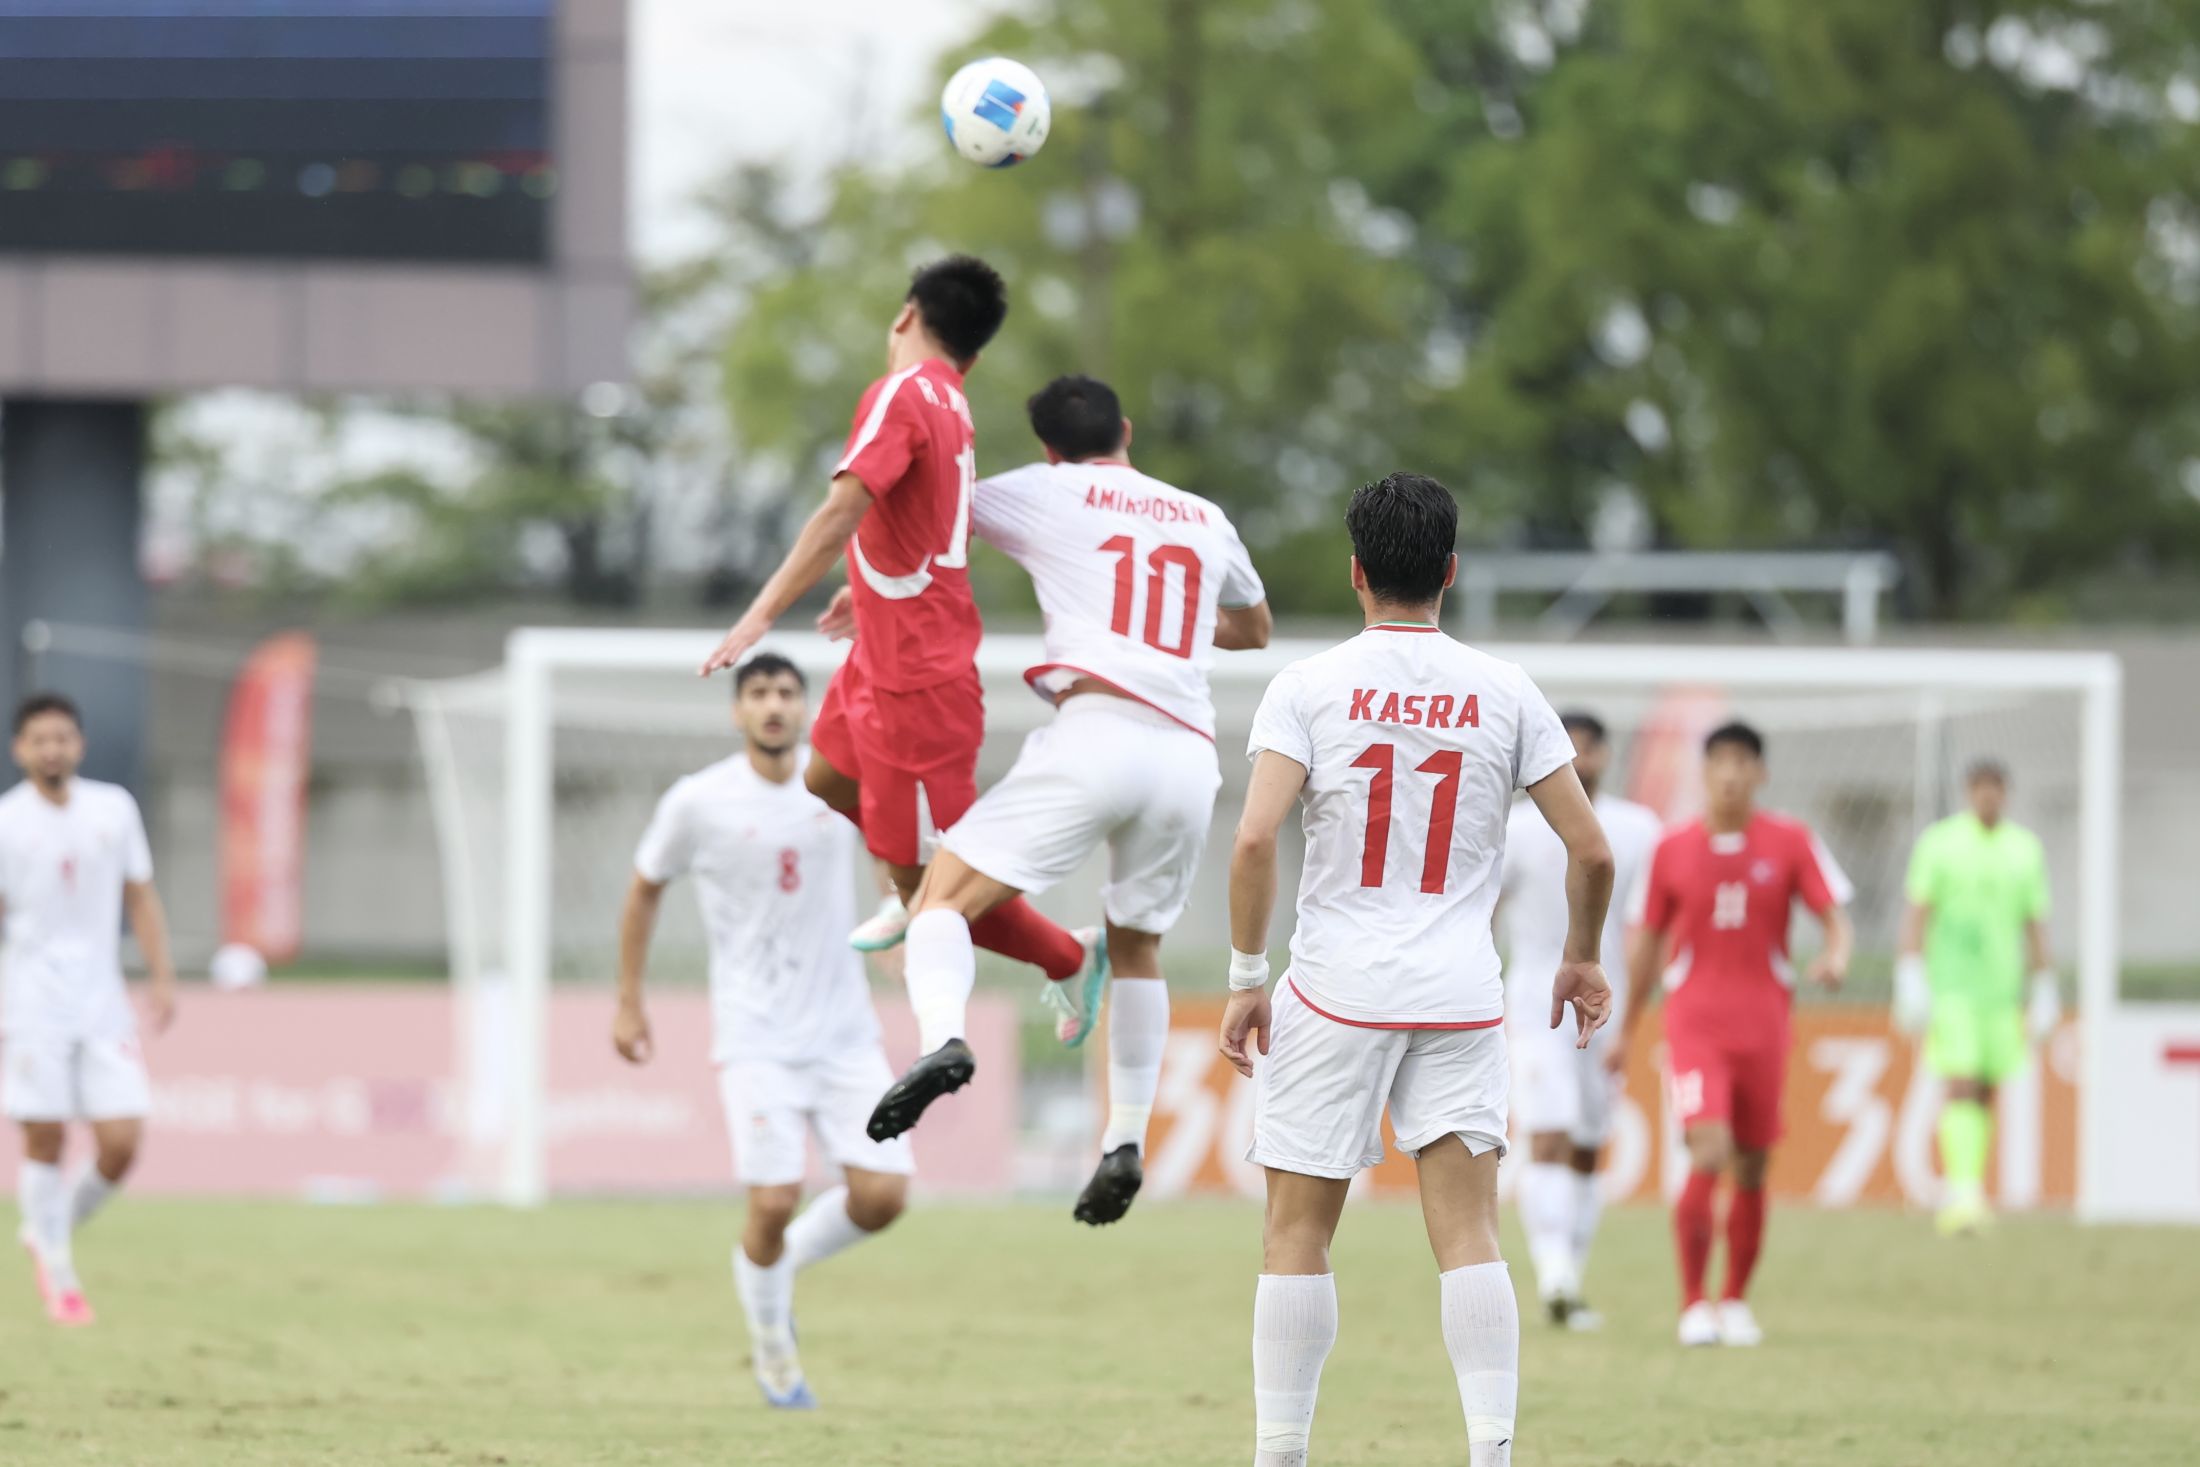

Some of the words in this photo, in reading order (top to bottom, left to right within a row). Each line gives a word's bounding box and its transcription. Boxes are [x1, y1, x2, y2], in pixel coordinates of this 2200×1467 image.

[1098, 534, 1203, 659] 10
[1348, 688, 1480, 729] KASRA
[1350, 743, 1464, 895] 11
[777, 848, 801, 895] 8
